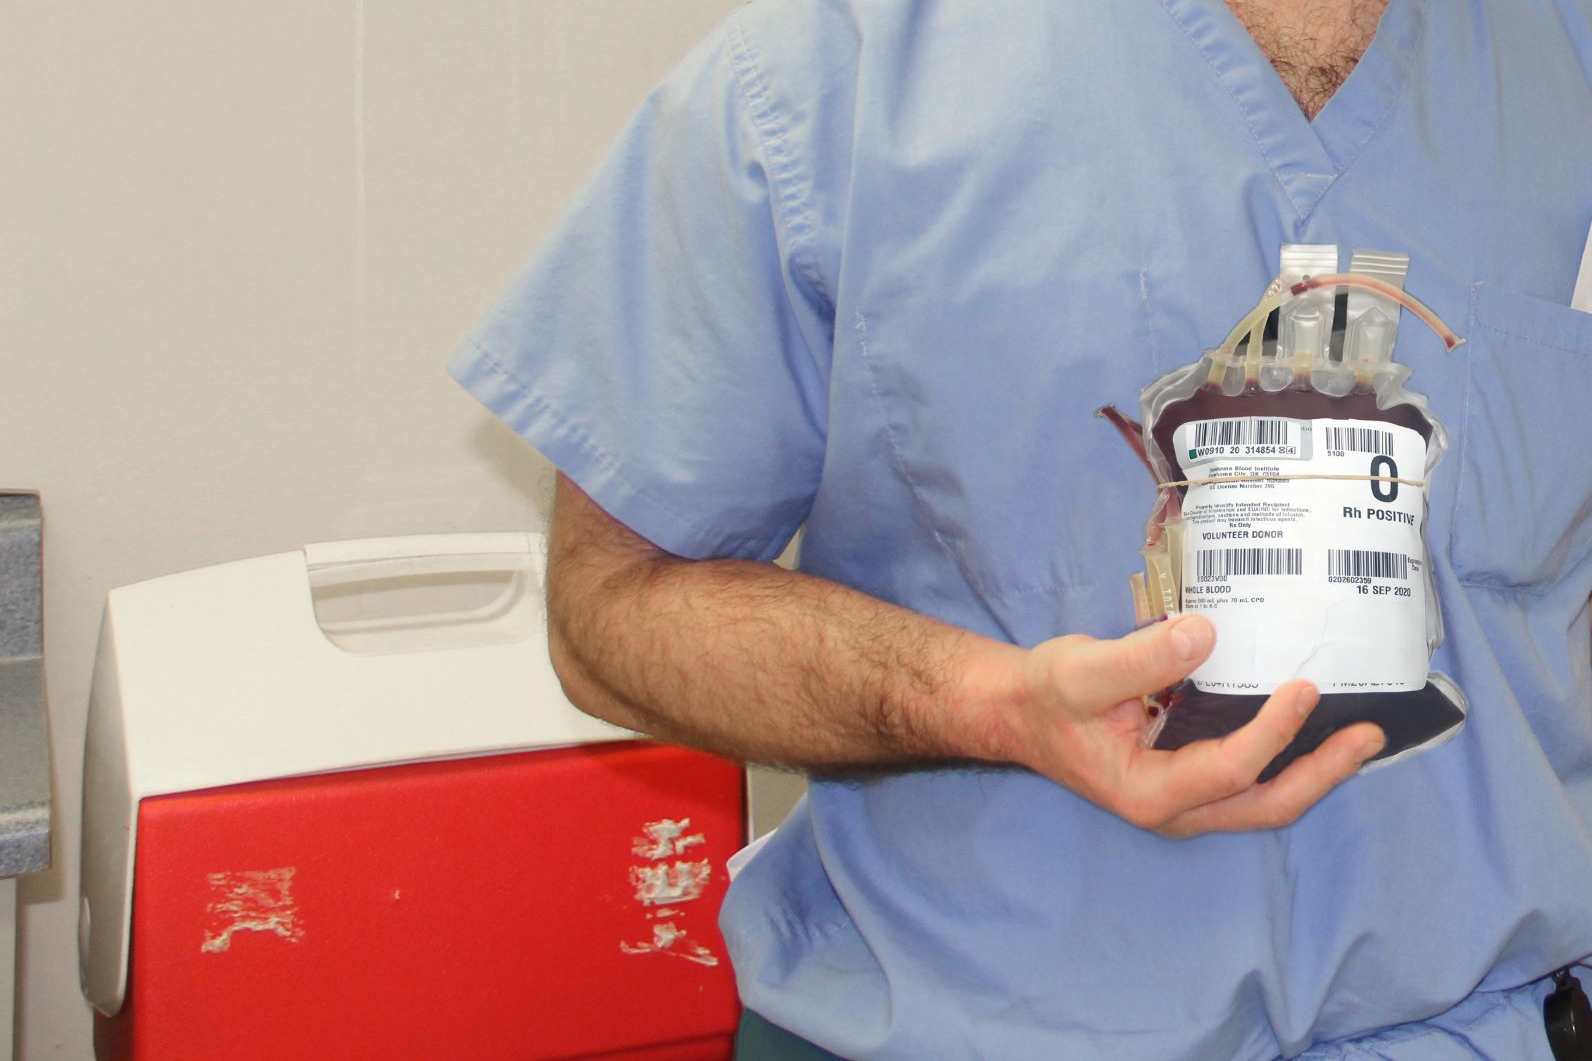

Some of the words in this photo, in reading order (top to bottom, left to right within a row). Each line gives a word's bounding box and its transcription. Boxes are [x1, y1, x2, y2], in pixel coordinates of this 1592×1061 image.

[1198, 446, 1224, 457] W0910
[1245, 446, 1276, 454] 314854
[1343, 506, 1361, 519] Rh
[1366, 508, 1415, 526] POSITIVE
[1202, 531, 1249, 540] VOLUNTEER
[1251, 530, 1283, 538] DONOR
[1328, 576, 1372, 584] 0202602359
[1185, 586, 1203, 594] WHOLE
[1205, 585, 1231, 594] BLOOD
[1356, 585, 1368, 594] 16
[1373, 585, 1391, 595] SEP
[1394, 587, 1411, 597] 2020
